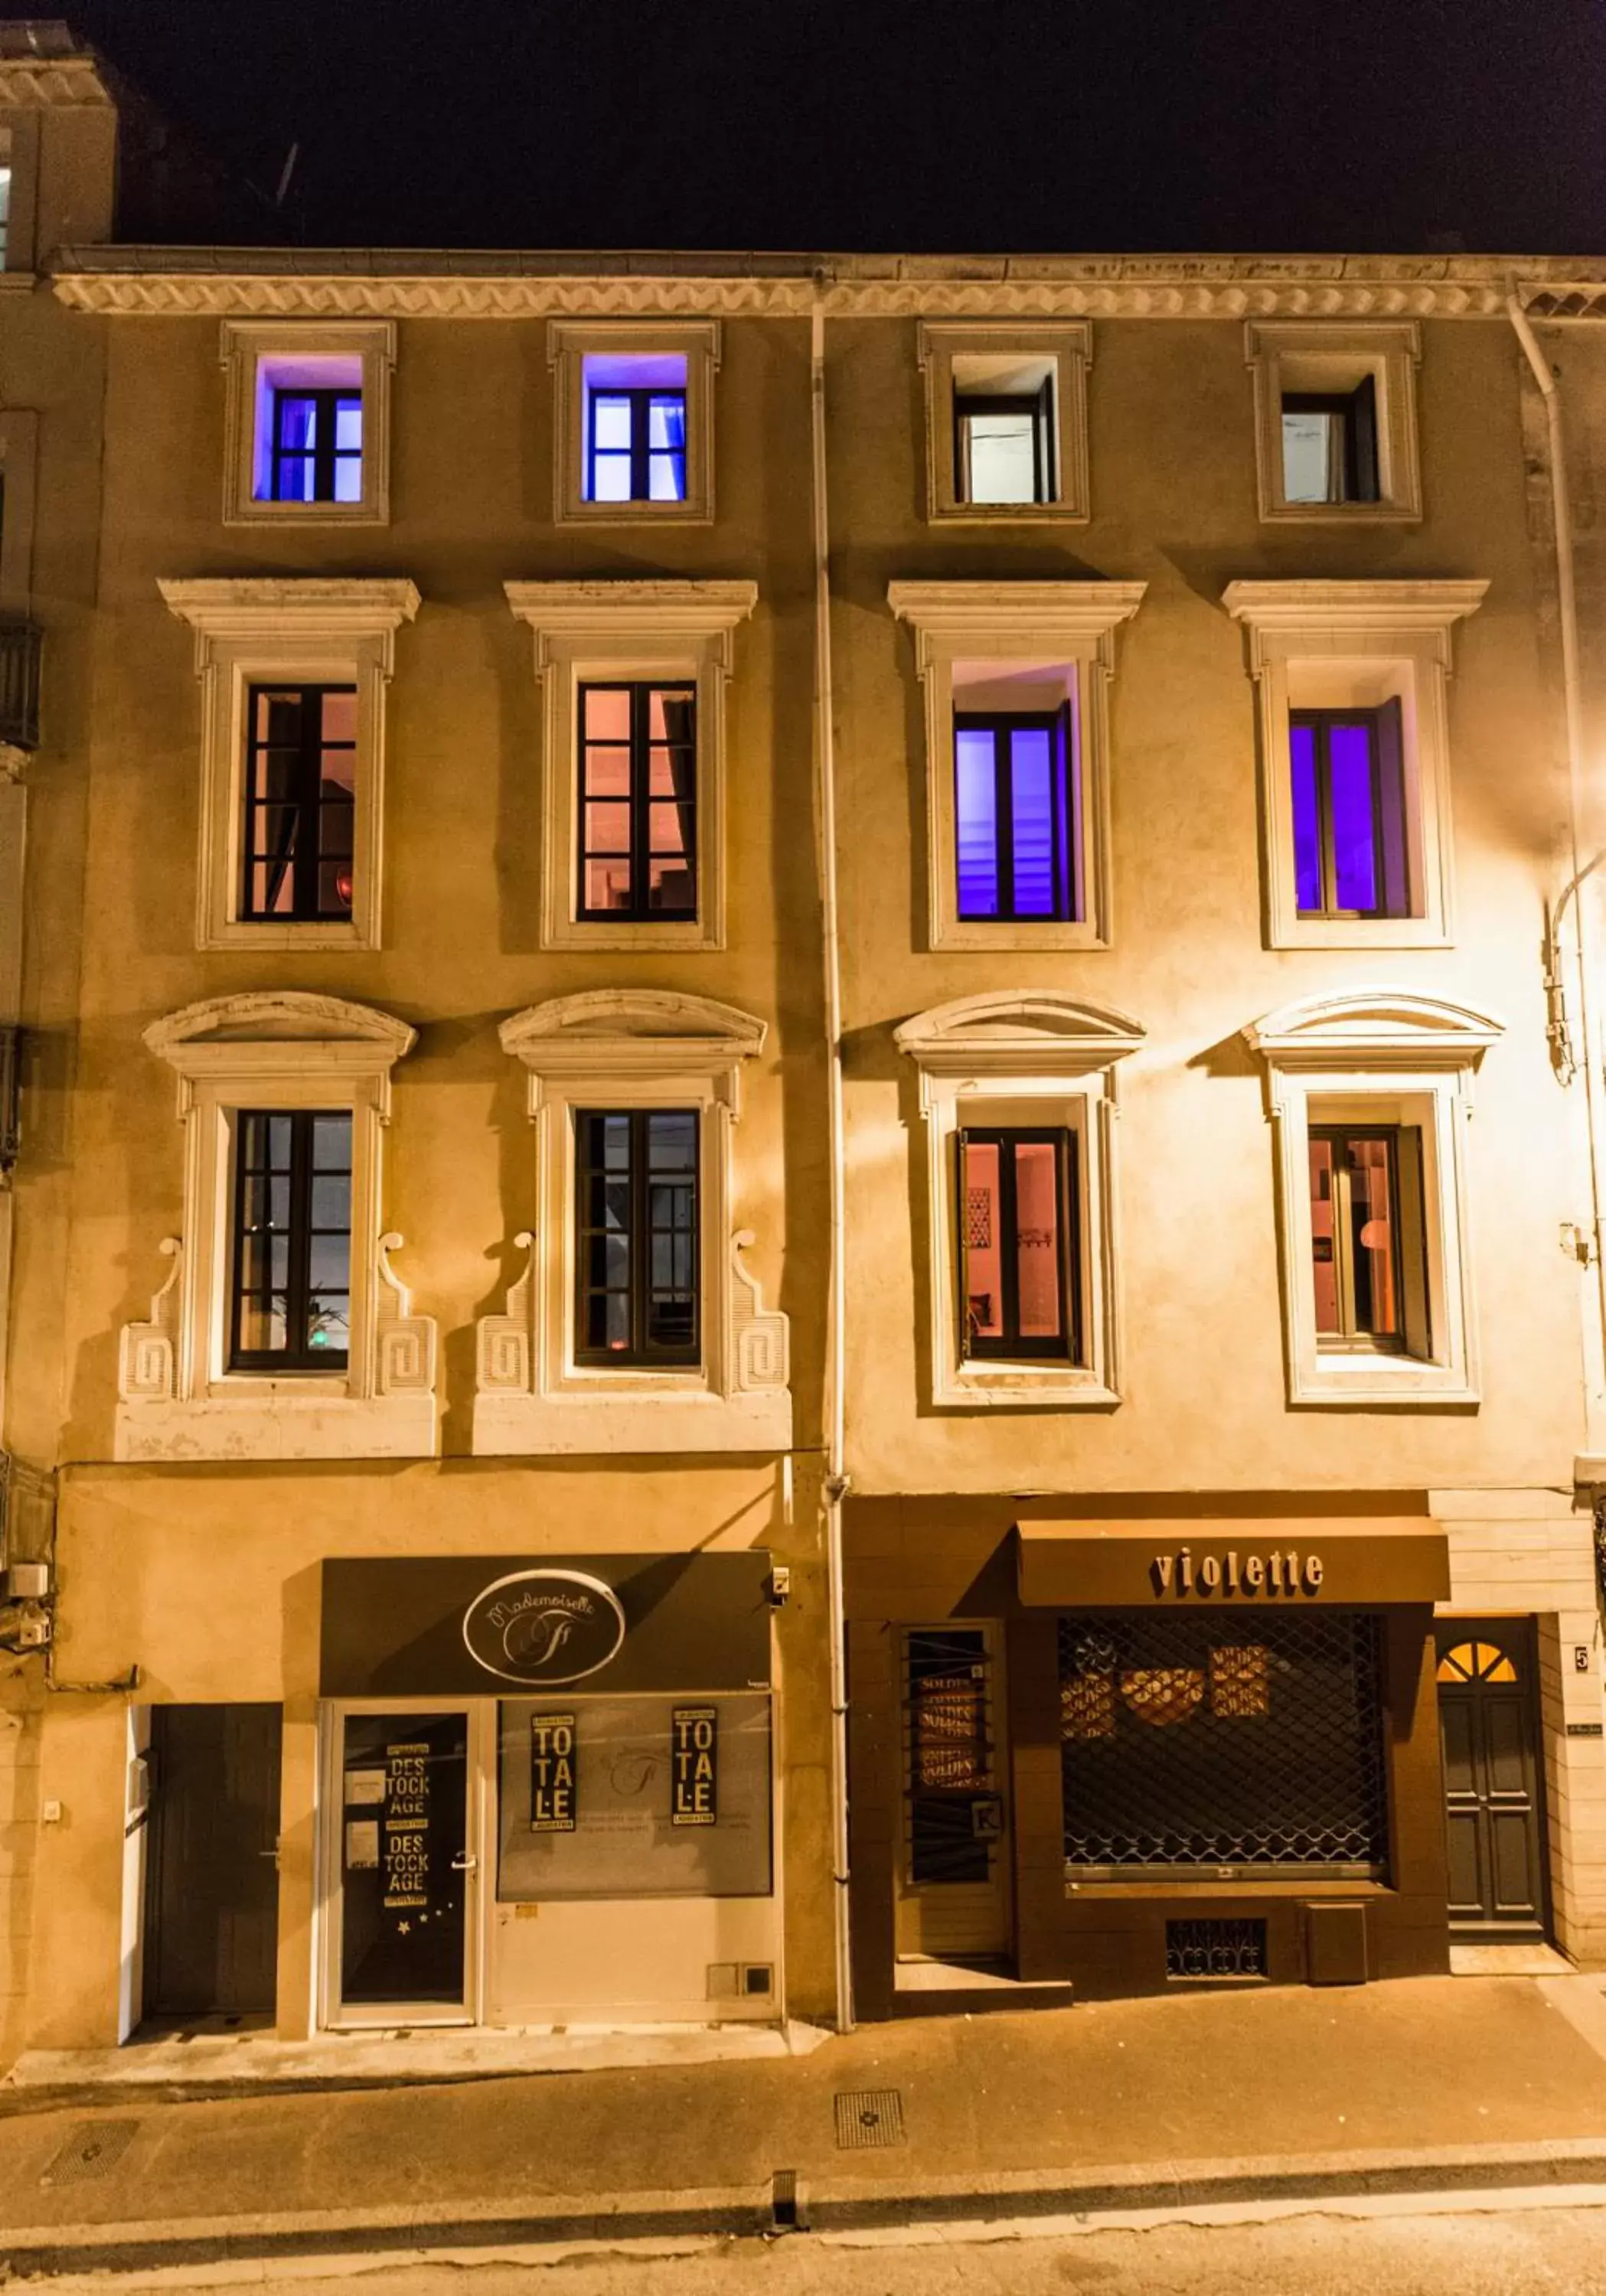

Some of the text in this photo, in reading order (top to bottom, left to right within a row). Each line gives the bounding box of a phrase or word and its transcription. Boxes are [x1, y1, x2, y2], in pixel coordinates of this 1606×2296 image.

[1155, 1547, 1324, 1587] violette
[486, 1591, 596, 1629] Mademoiselle
[1577, 1649, 1588, 1668] 5
[391, 1758, 425, 1776] DES
[390, 1795, 424, 1814] AGE
[390, 1836, 423, 1854] DES
[384, 1854, 429, 1872] TOCK
[388, 1873, 423, 1892] AGE
